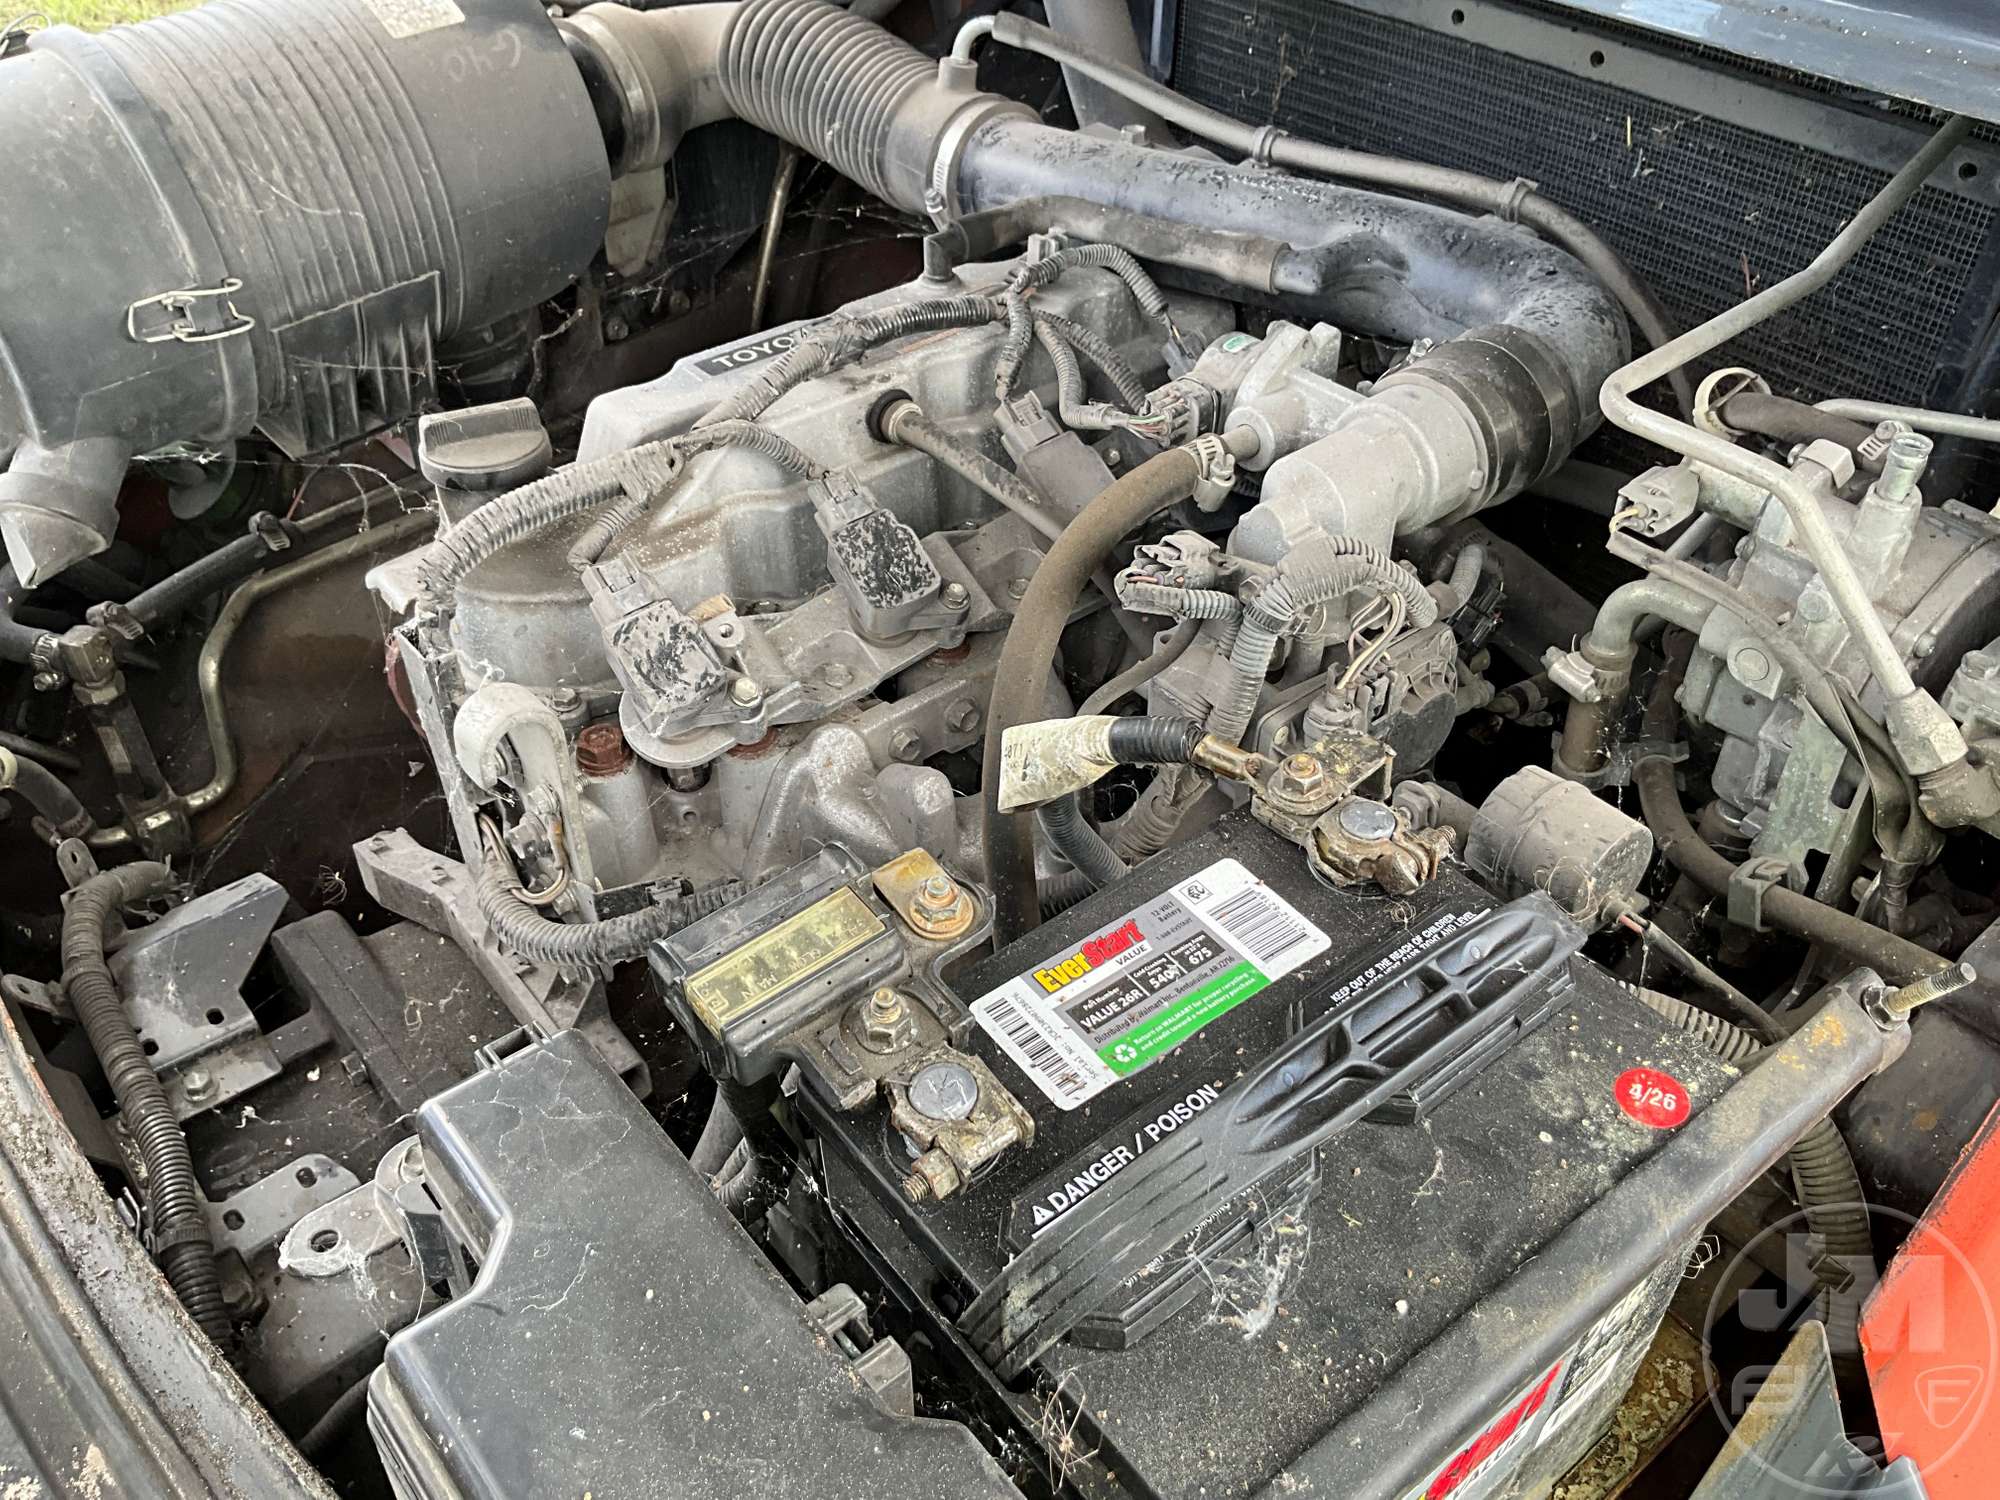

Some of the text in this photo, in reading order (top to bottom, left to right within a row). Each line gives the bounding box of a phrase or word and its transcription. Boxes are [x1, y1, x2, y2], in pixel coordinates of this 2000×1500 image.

[711, 336, 796, 369] TOYO
[1455, 911, 1477, 928] LEVEL
[1032, 918, 1146, 993] EverStart
[1115, 943, 1148, 964] VALUE
[1187, 946, 1212, 965] 675
[1330, 984, 1350, 1002] KEEP
[1349, 976, 1366, 993] OUT
[1374, 957, 1393, 971] THE
[1388, 940, 1414, 963] REACH
[1421, 913, 1456, 939] CHILDREN
[1132, 968, 1146, 978] Cold
[1148, 969, 1175, 988] 540
[1079, 988, 1143, 1029] VALUE 26R
[1093, 1018, 1130, 1043] Distributed
[1137, 997, 1164, 1017] Walmart
[1161, 1006, 1192, 1027] WALMART
[1629, 1083, 1677, 1111] 4/26
[1047, 1083, 1219, 1213] DANGER / POISON
